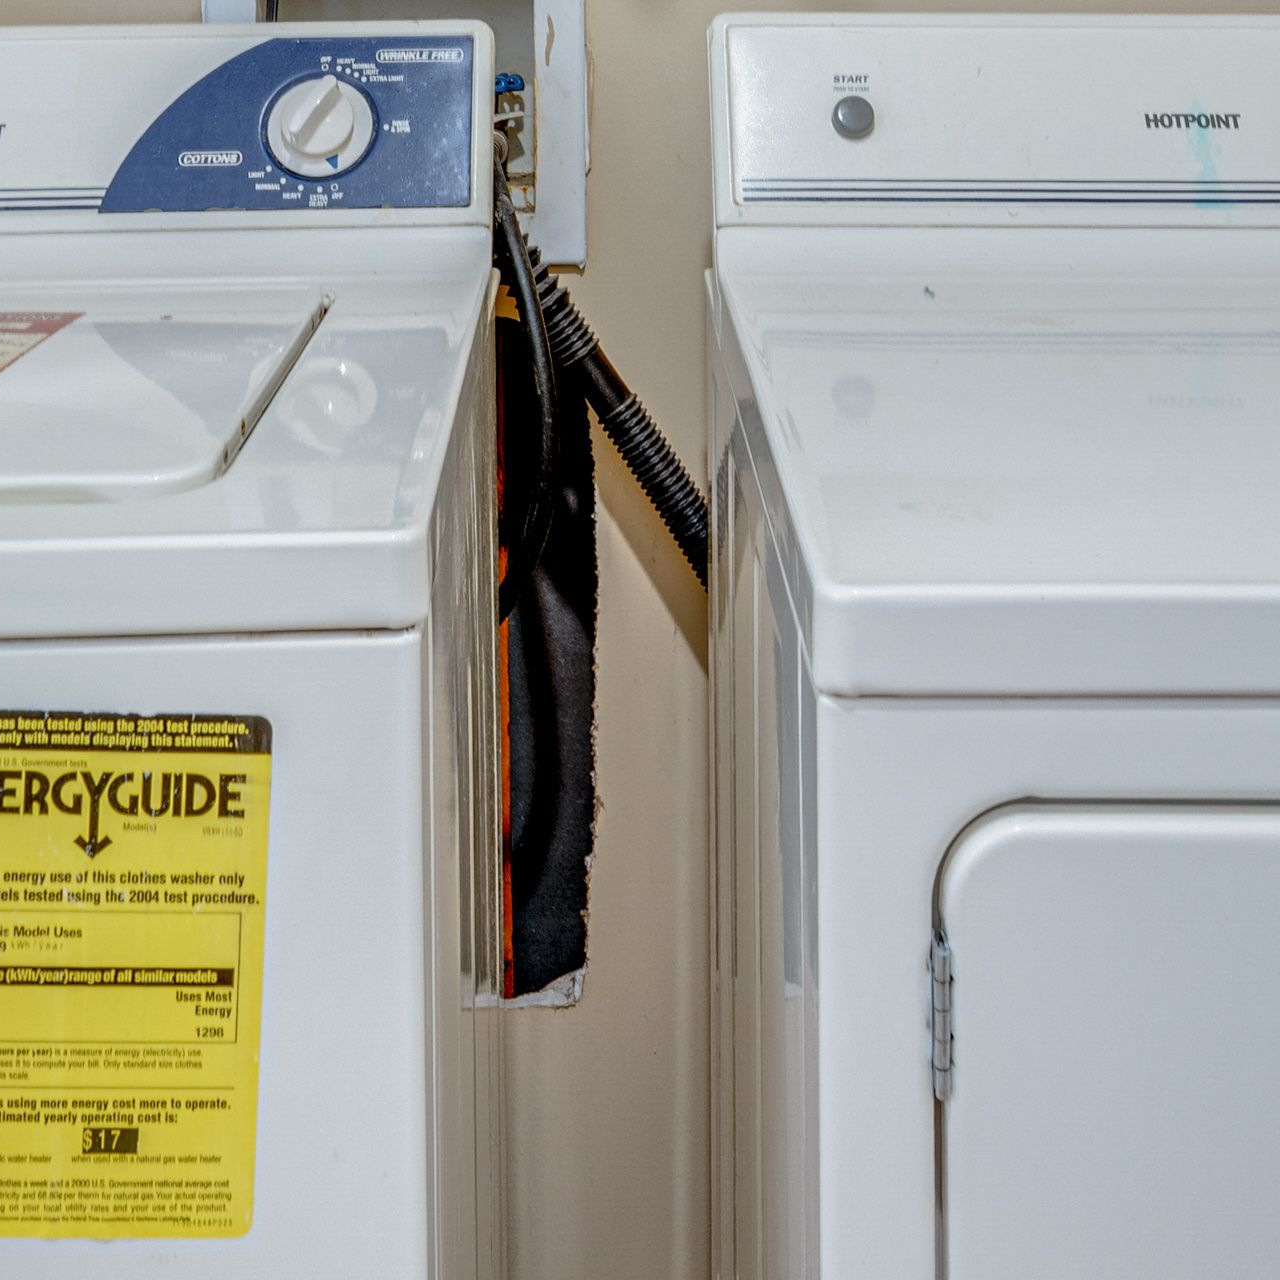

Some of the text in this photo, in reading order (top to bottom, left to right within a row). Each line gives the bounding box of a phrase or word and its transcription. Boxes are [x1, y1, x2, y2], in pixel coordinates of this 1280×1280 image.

[380, 51, 459, 60] WRINKLE FREE
[833, 75, 869, 83] START
[1144, 113, 1240, 129] HOTPOINT
[183, 153, 237, 164] COTTONS
[255, 183, 280, 191] NORMAL
[18, 716, 45, 730] been
[47, 717, 82, 731] tested
[84, 718, 114, 733] using
[117, 719, 134, 732] the
[137, 720, 164, 732] 2004
[166, 720, 188, 733] test
[191, 720, 249, 735] procedure.
[0, 731, 21, 746] only
[25, 731, 49, 744] with
[51, 732, 92, 745] models
[93, 732, 148, 748] displaying
[151, 734, 172, 747] this
[174, 734, 234, 748] statement.
[3, 872, 45, 885] energy
[50, 873, 71, 883] use
[76, 871, 88, 883] of
[92, 871, 116, 884] this
[120, 872, 166, 884] clothes
[171, 872, 215, 884] washer
[219, 873, 245, 888] only
[24, 889, 63, 902] tested
[67, 890, 101, 905] using
[105, 890, 125, 902] the
[129, 891, 159, 903] 2004
[164, 891, 187, 903] test
[191, 891, 260, 906] procedure.
[13, 926, 50, 938] Model
[54, 927, 83, 938] Uses
[103, 969, 116, 982] of
[117, 969, 132, 982] all
[134, 969, 174, 982] similar
[176, 970, 218, 983] models
[176, 990, 232, 1002] Uses Most
[195, 1005, 232, 1018] Energy
[196, 1027, 223, 1038] 1298
[7, 1098, 36, 1110] using
[40, 1099, 68, 1109] more
[72, 1099, 109, 1111] energy
[112, 1099, 136, 1109] cost
[140, 1100, 167, 1109] more
[171, 1099, 181, 1109] to
[185, 1098, 231, 1111] operate.
[44, 1112, 77, 1124] yearly
[81, 1112, 134, 1125] operating
[138, 1113, 161, 1122] cost
[83, 1130, 121, 1151] $17
